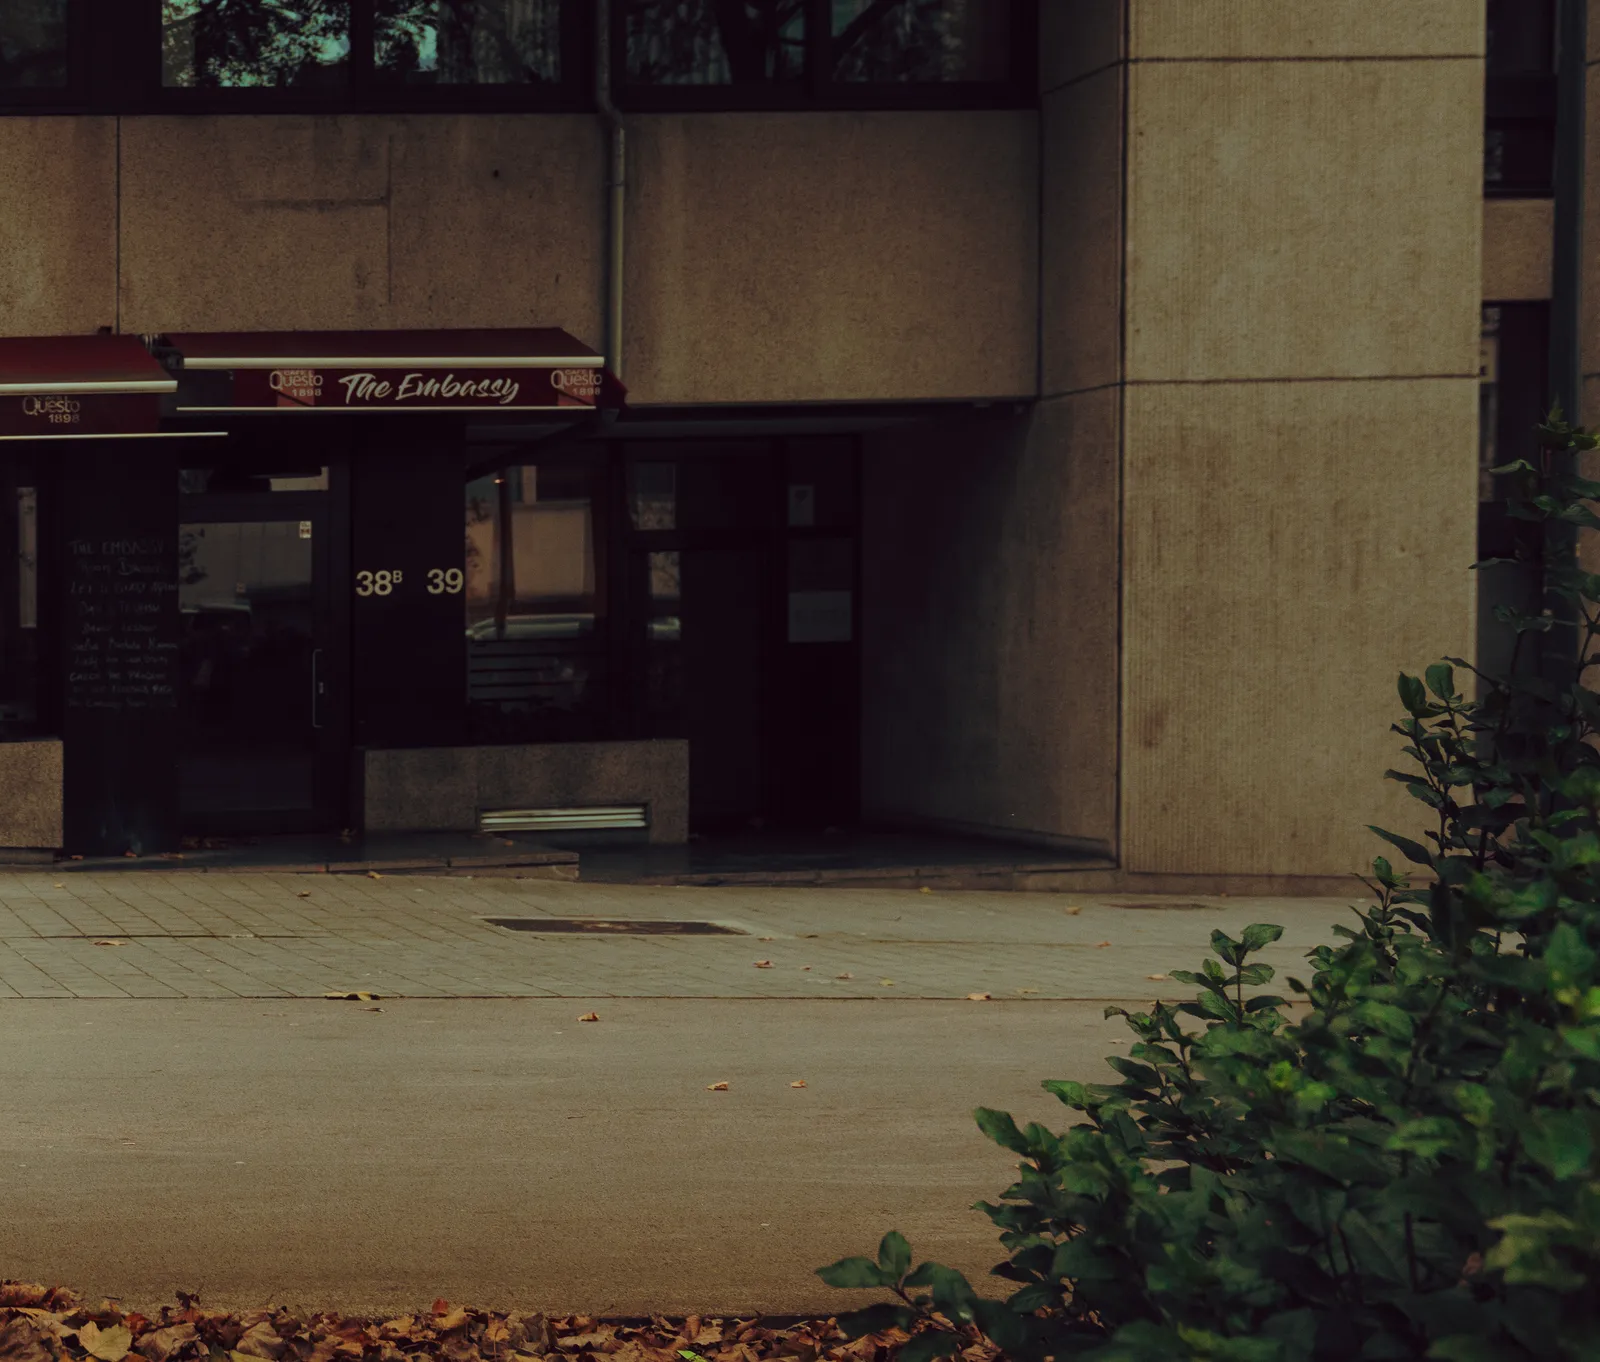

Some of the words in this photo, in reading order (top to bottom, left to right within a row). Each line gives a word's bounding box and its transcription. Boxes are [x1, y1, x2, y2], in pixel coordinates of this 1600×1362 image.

[269, 370, 324, 391] Questo
[338, 373, 393, 404] The
[394, 373, 520, 404] Embassy
[550, 369, 603, 391] Questo
[291, 388, 322, 397] 1898
[22, 395, 80, 416] Questo
[48, 413, 80, 424] 1898
[426, 569, 464, 595] 39
